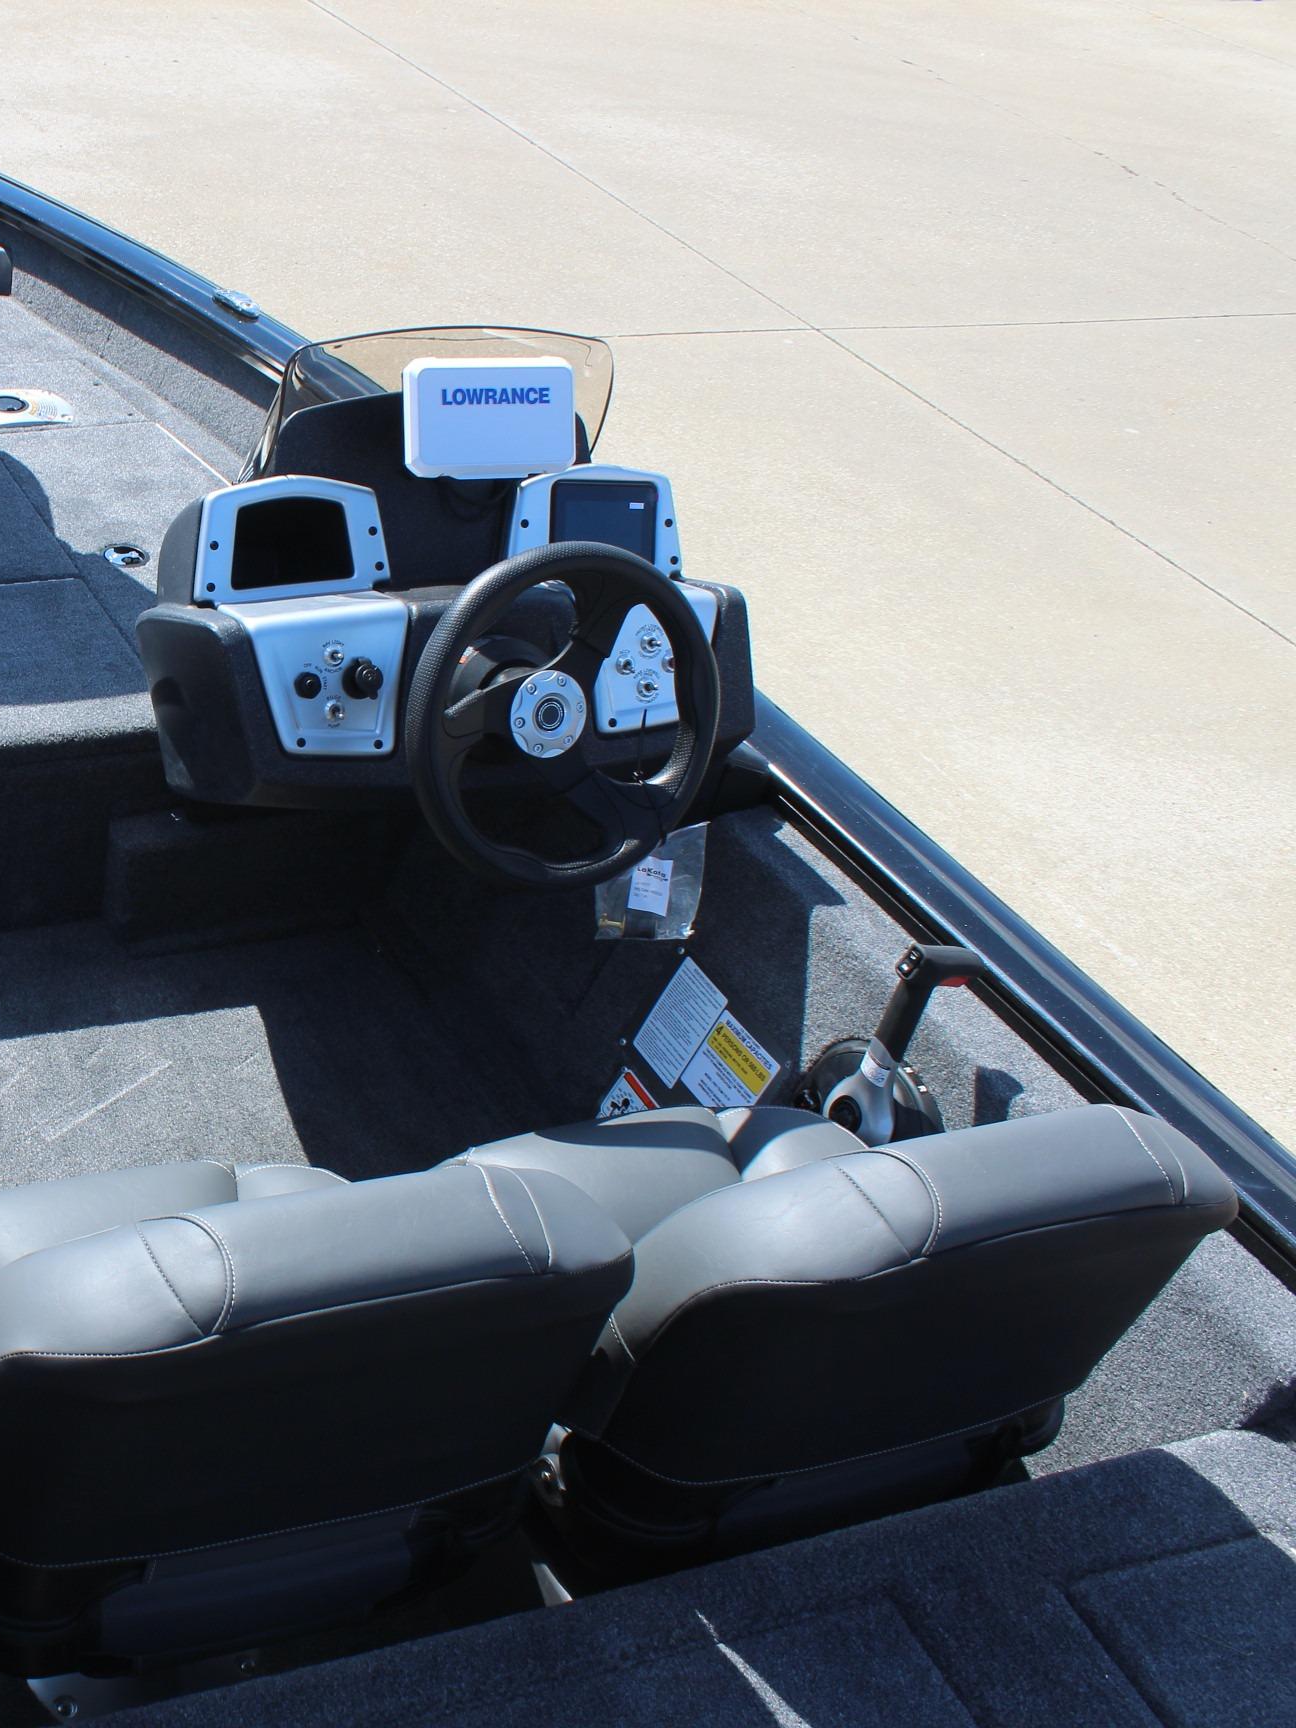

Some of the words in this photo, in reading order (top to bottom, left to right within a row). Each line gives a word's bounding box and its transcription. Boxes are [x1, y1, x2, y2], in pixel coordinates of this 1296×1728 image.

[441, 387, 551, 405] LOWRANCE
[715, 1025, 724, 1035] 4
[721, 1032, 743, 1057] PERSONS
[725, 1018, 747, 1043] MAXIMUM
[745, 1040, 773, 1071] CAPACITIES
